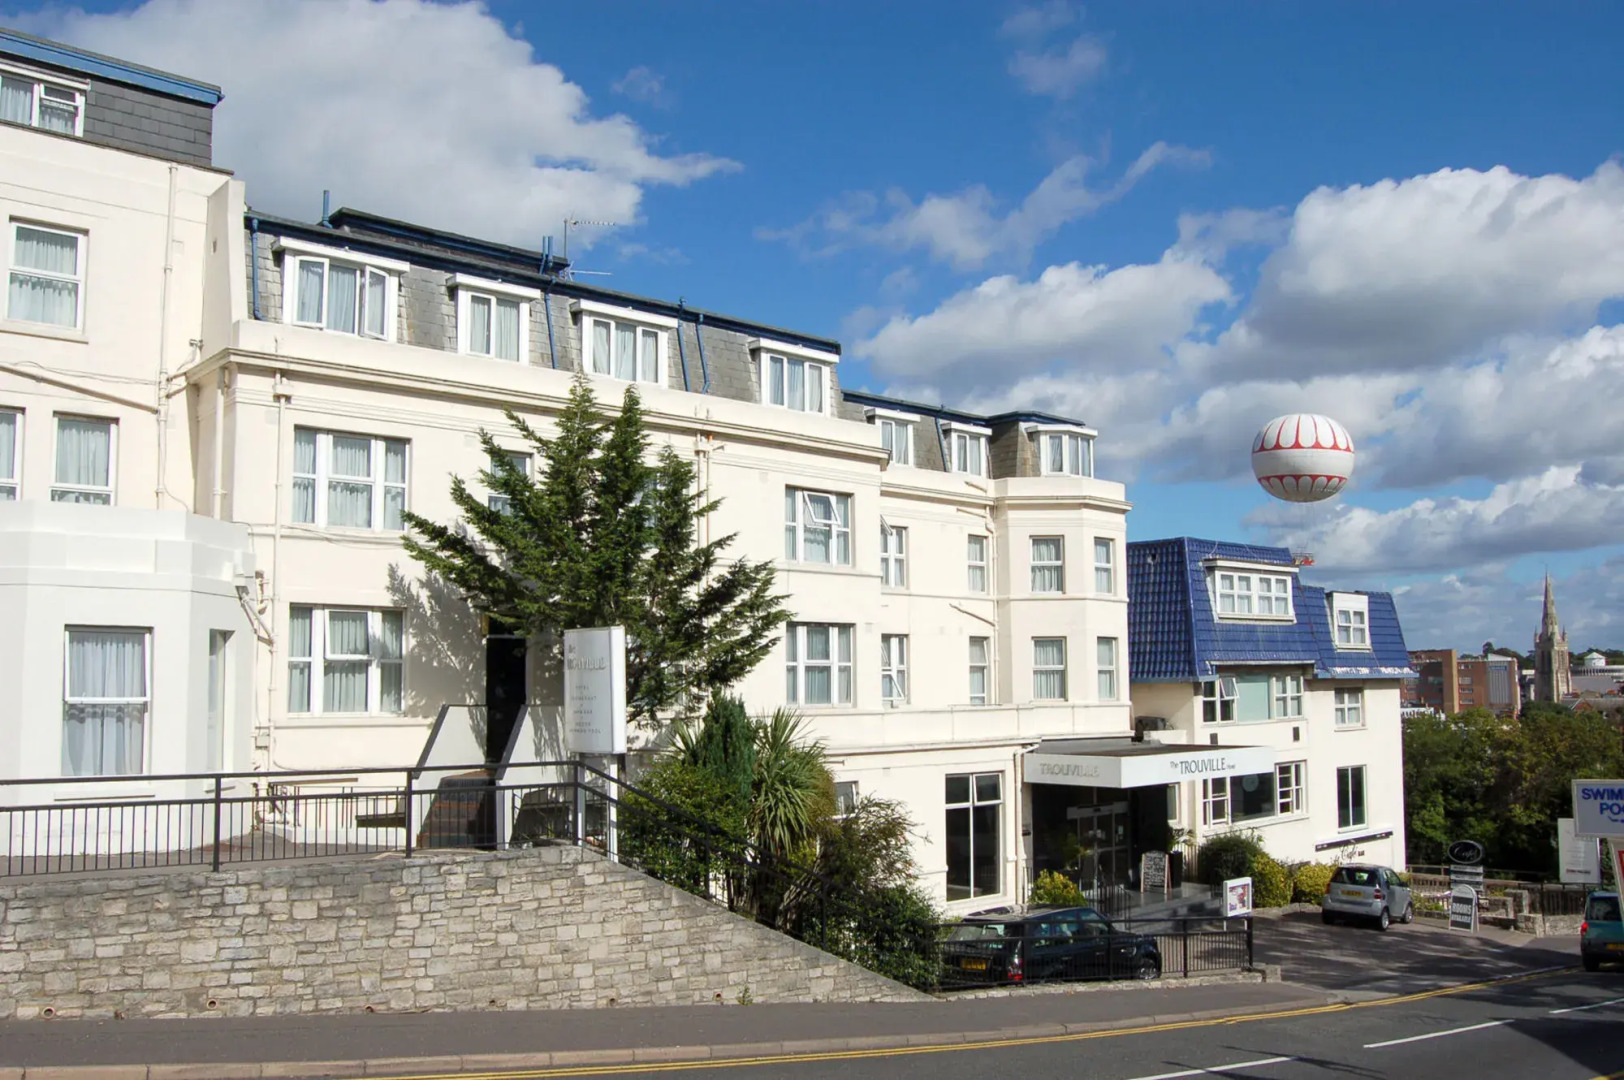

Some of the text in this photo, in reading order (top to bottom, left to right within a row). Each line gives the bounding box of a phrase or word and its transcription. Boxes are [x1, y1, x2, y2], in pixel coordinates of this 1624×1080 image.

[1040, 762, 1100, 777] TROUVILLE
[1179, 757, 1226, 774] TROUVILLE
[1599, 802, 1624, 816] PO
